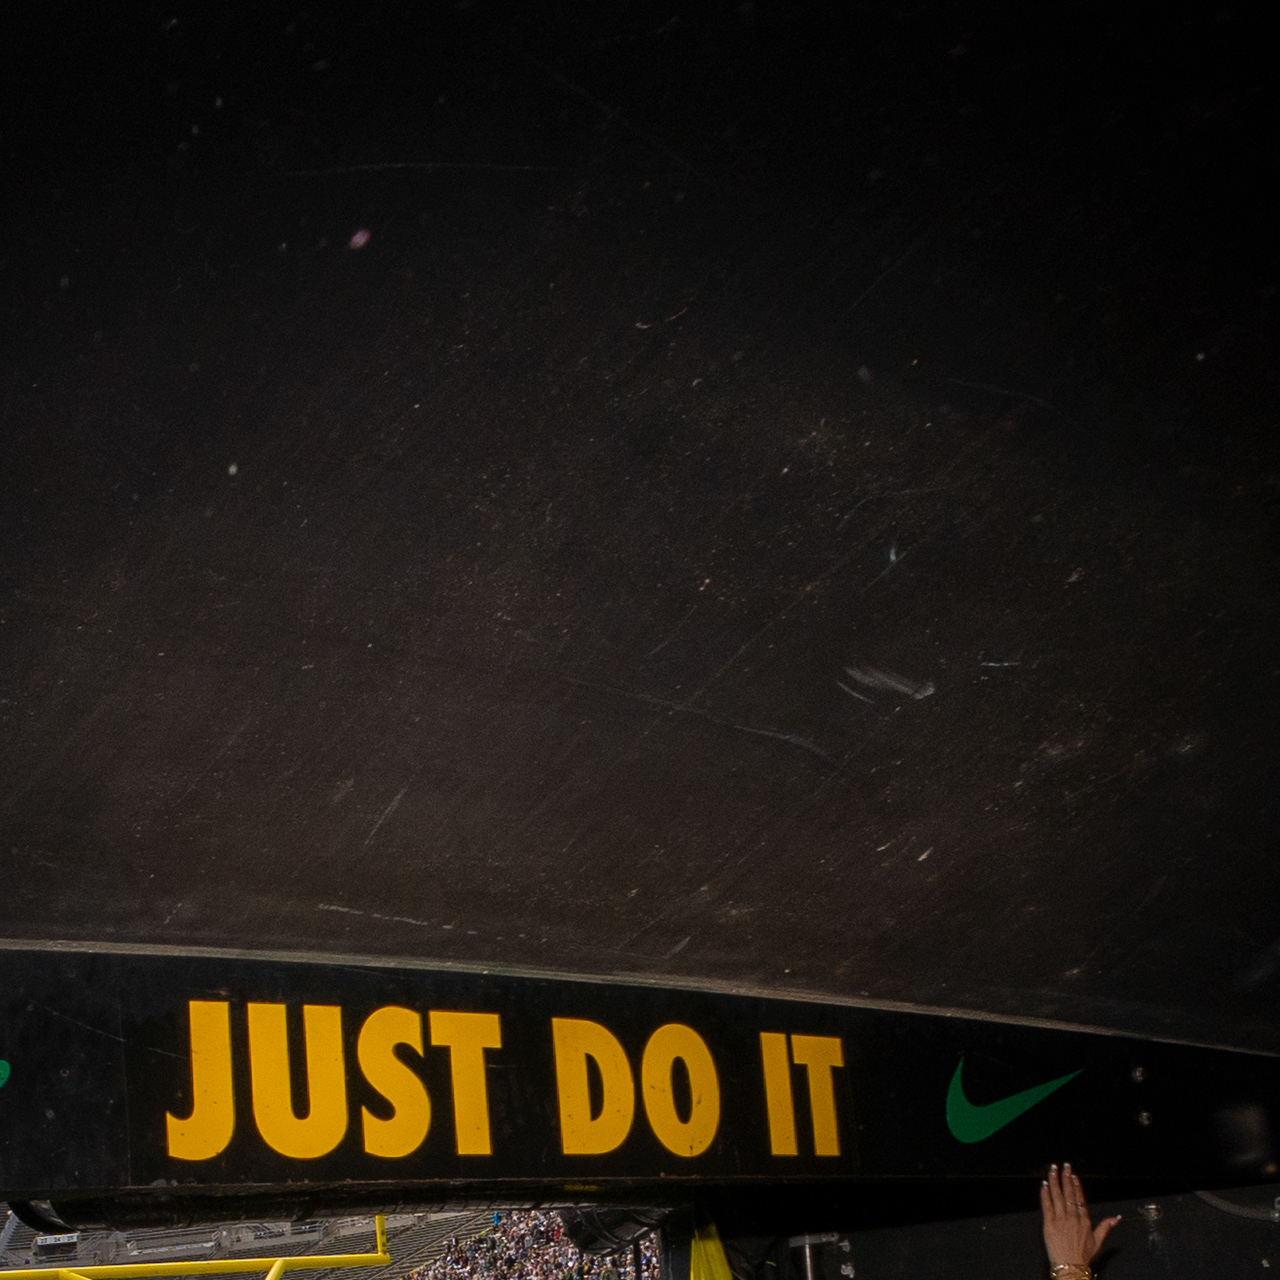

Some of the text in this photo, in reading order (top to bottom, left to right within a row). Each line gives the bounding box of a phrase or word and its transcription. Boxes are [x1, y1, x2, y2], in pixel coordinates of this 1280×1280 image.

[166, 1000, 845, 1161] JUST DO IT
